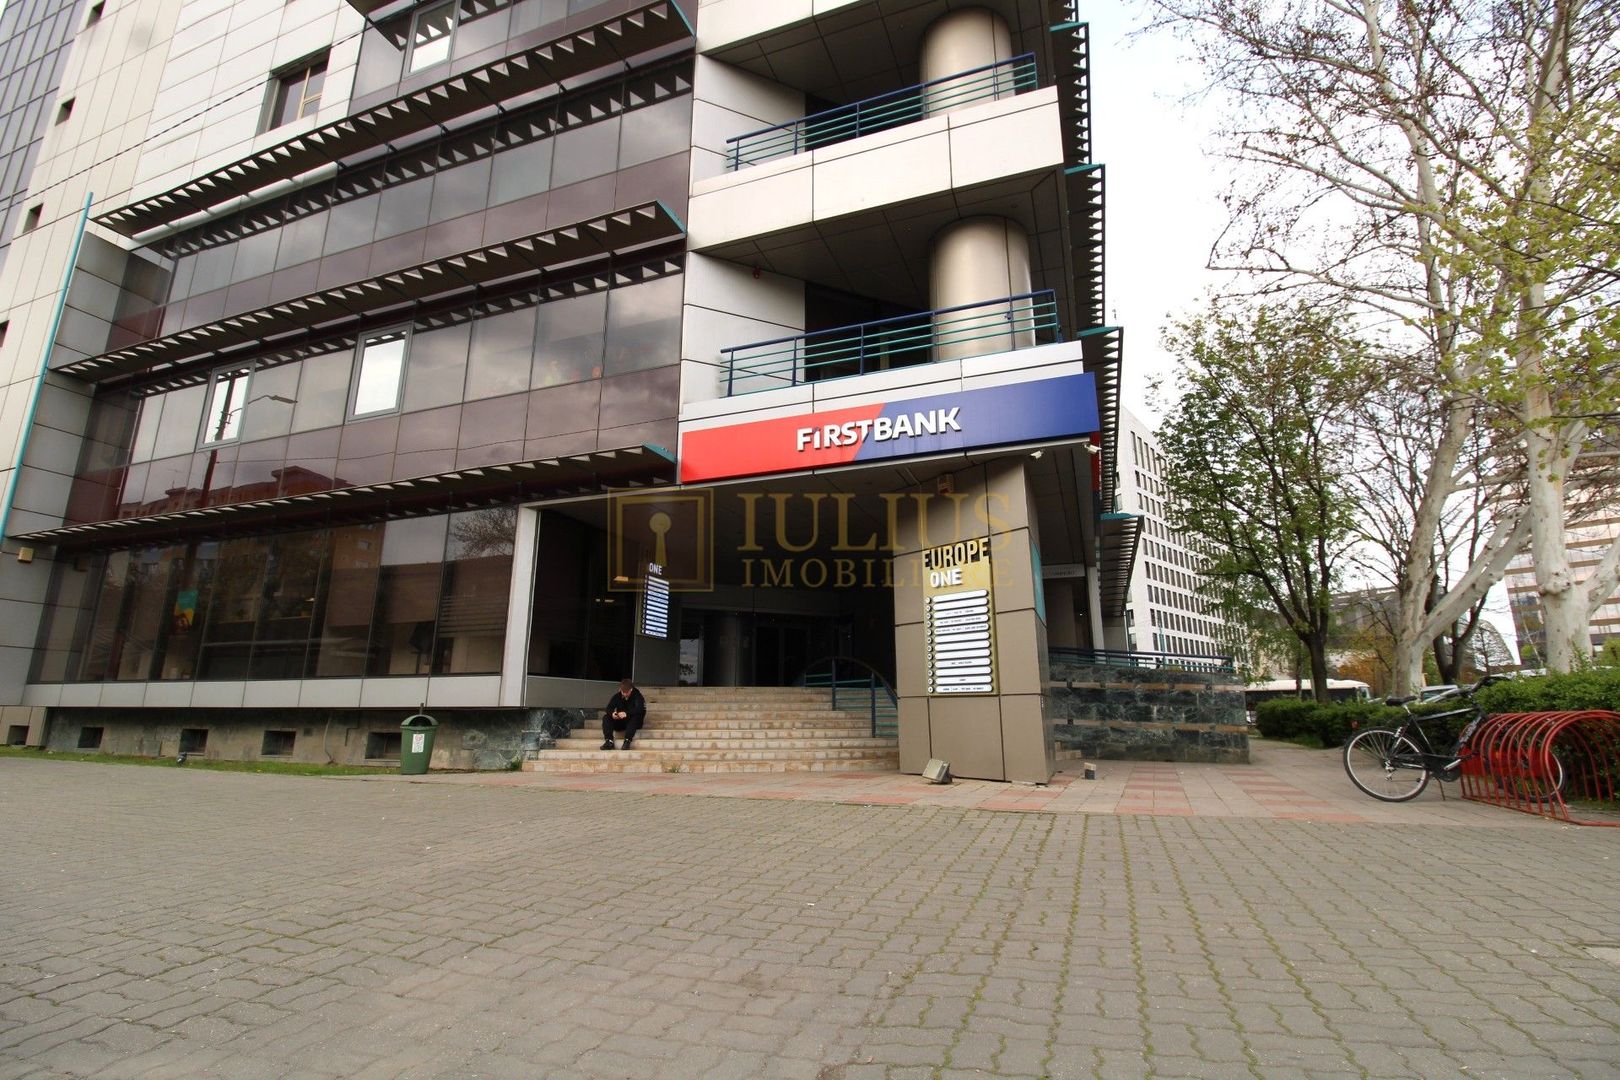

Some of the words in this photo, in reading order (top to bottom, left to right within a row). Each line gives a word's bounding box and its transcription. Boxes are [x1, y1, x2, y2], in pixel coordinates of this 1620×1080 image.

[922, 538, 990, 570] EUROPE
[649, 562, 662, 576] ONE
[930, 568, 963, 588] ONE
